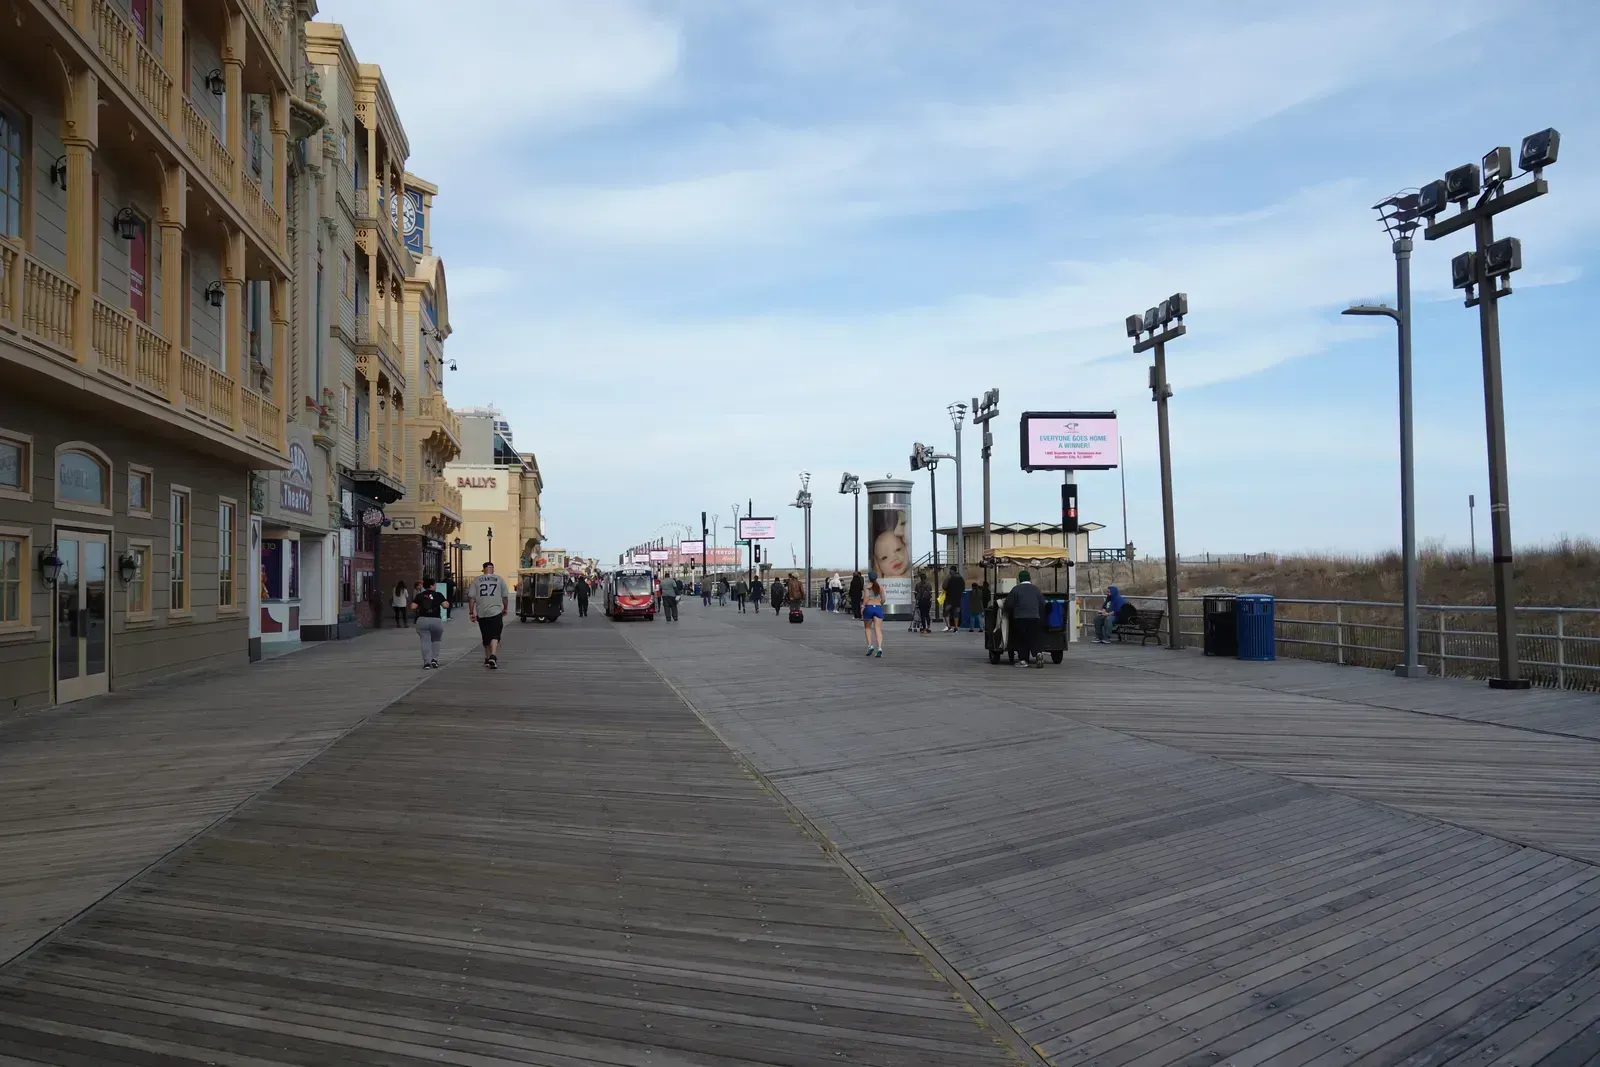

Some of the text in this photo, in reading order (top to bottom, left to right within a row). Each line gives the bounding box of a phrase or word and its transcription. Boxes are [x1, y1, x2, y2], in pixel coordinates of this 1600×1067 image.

[457, 476, 497, 489] BALLY'S
[283, 484, 310, 512] Theatre
[480, 583, 498, 597] 27
